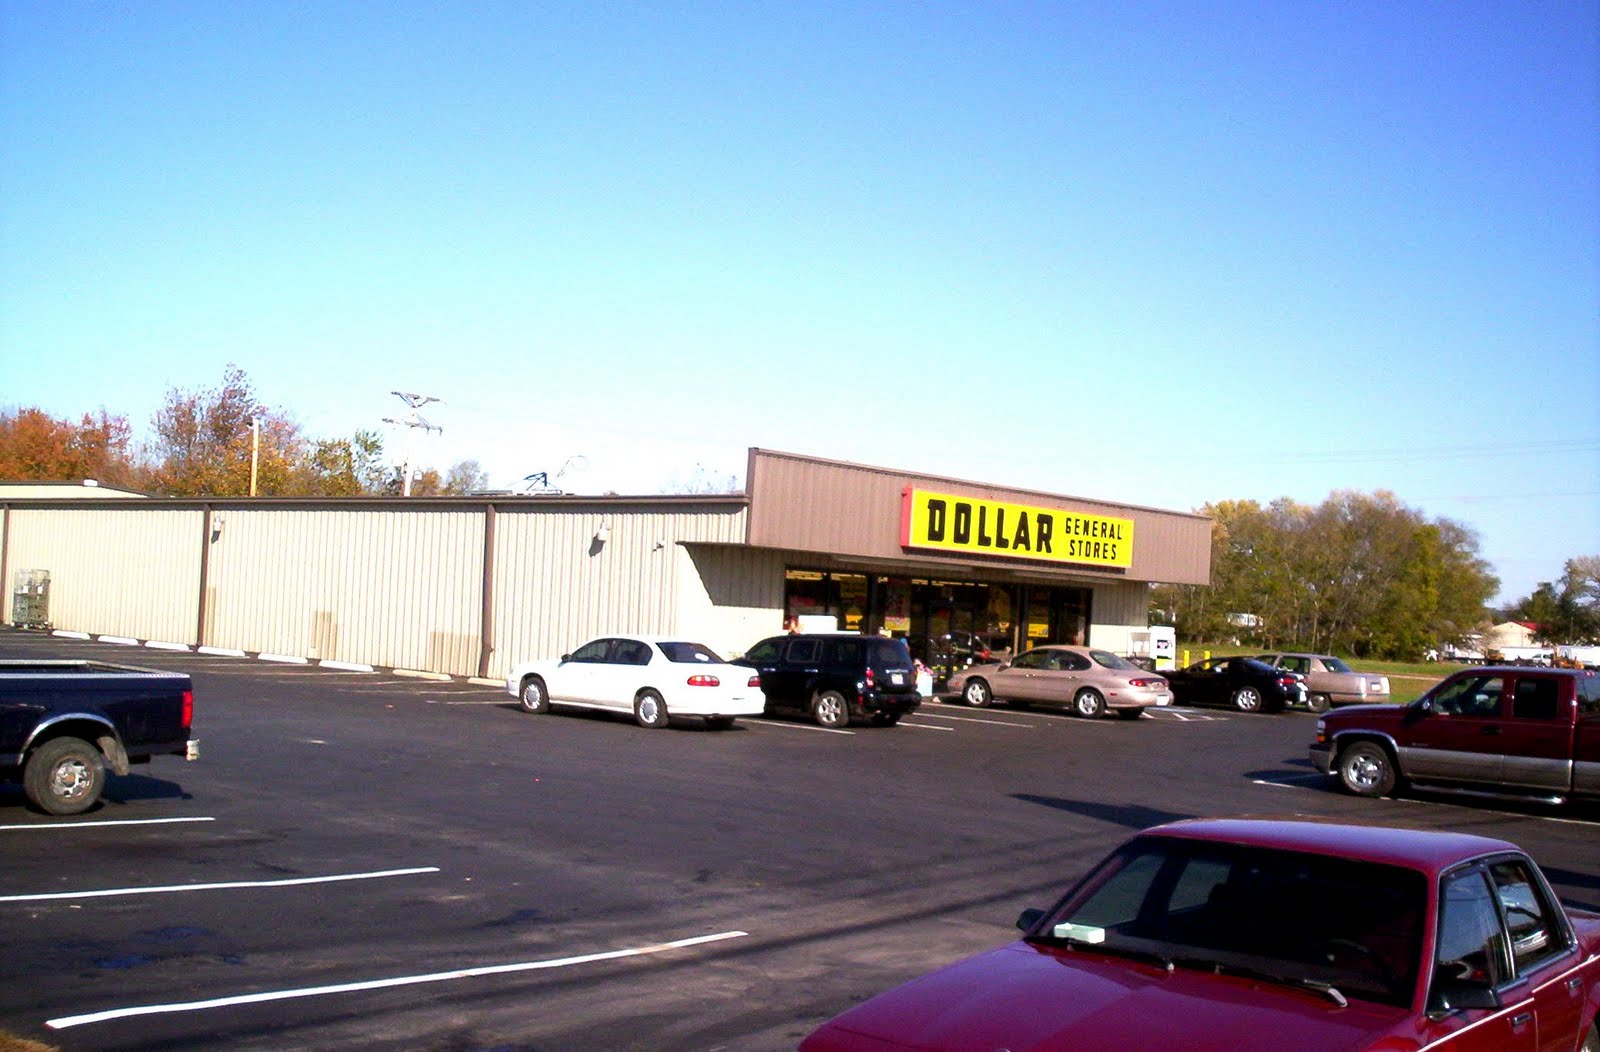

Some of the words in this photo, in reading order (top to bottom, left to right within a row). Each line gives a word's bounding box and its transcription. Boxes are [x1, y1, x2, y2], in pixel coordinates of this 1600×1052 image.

[927, 498, 1053, 553] DOLLAR
[1065, 517, 1123, 540] GENERAL
[1069, 539, 1117, 560] STORES
